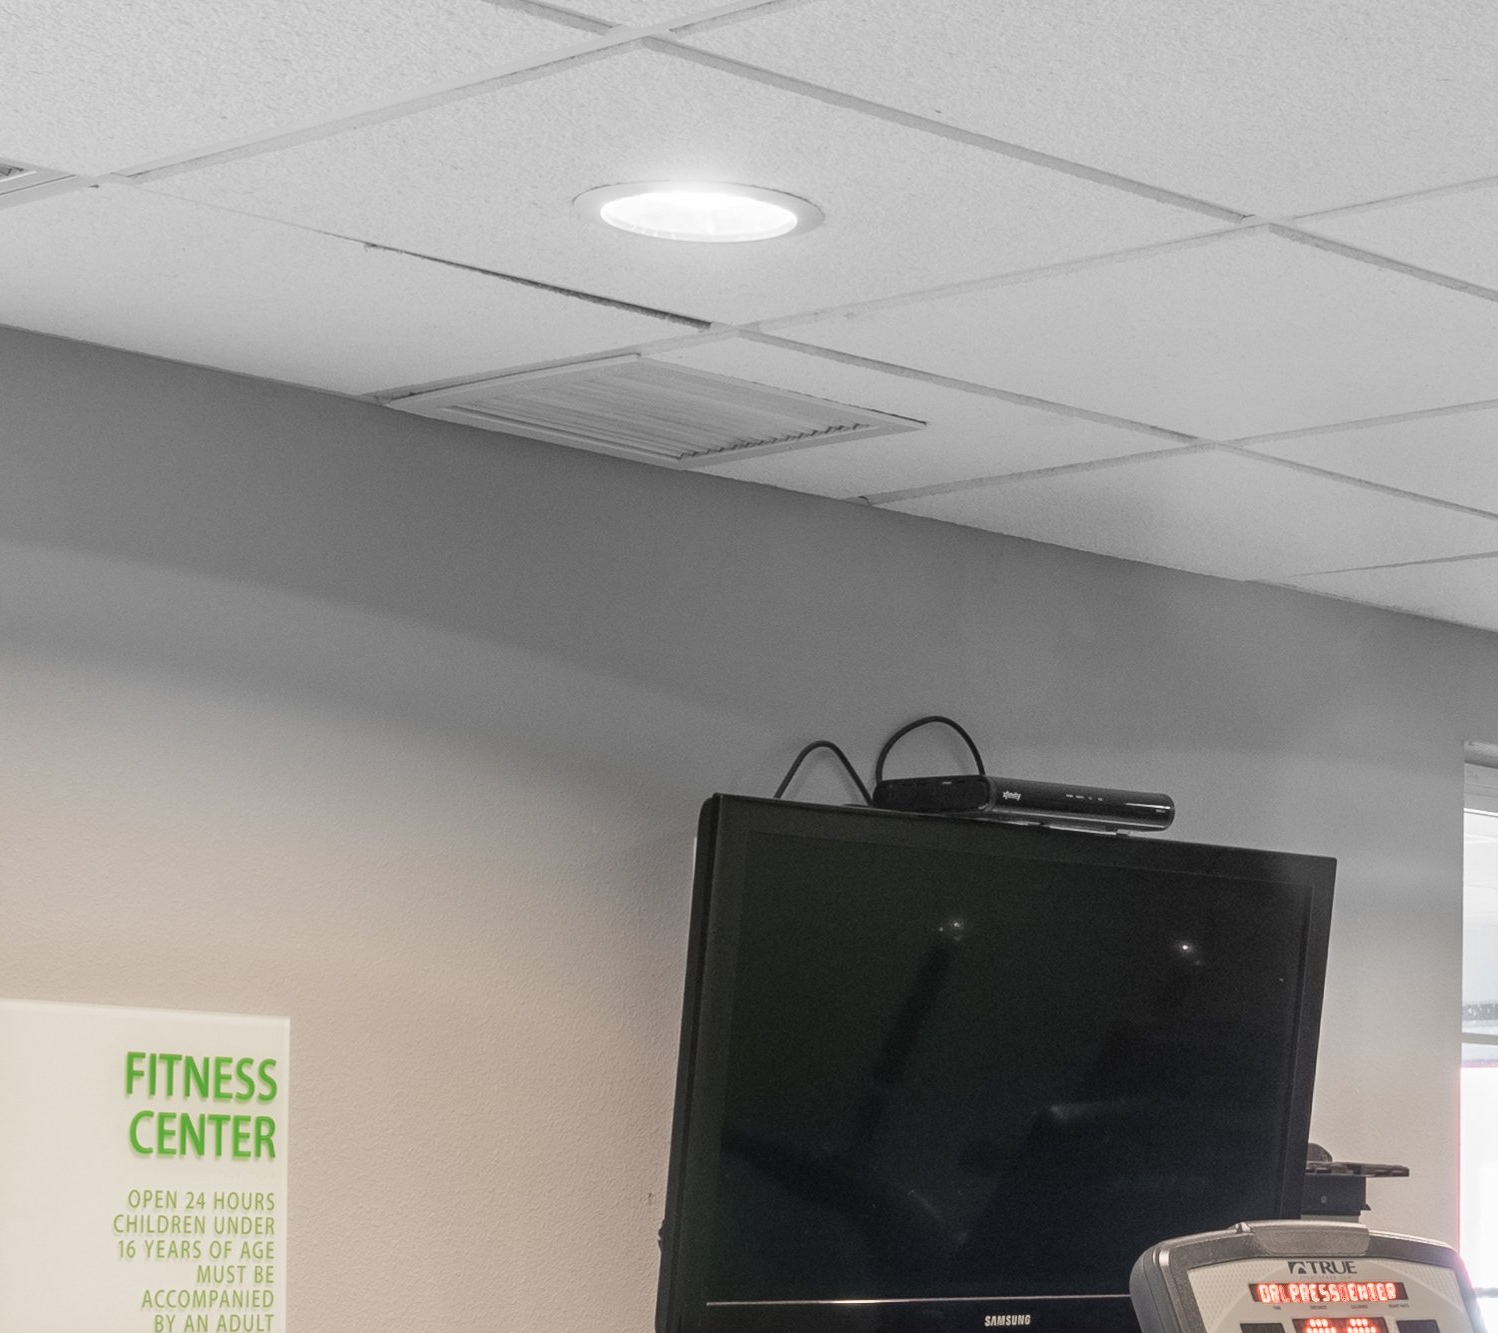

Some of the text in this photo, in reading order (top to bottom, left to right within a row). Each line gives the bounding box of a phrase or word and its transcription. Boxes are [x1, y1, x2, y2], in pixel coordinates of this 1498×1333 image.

[125, 1052, 277, 1101] FITNESS
[129, 1110, 276, 1158] CENTER
[128, 1190, 275, 1211] OPEN 24 HOURS
[113, 1214, 275, 1235] CHILDREN UNDER
[118, 1240, 275, 1259] 16 YEARS OF AGE
[197, 1265, 274, 1283] MUST BE
[1310, 1261, 1358, 1275] TRUE
[142, 1289, 274, 1308] ACCOMPANIED
[154, 1314, 274, 1333] BY AN ADULT
[984, 1314, 1031, 1327] SAMSUNG
